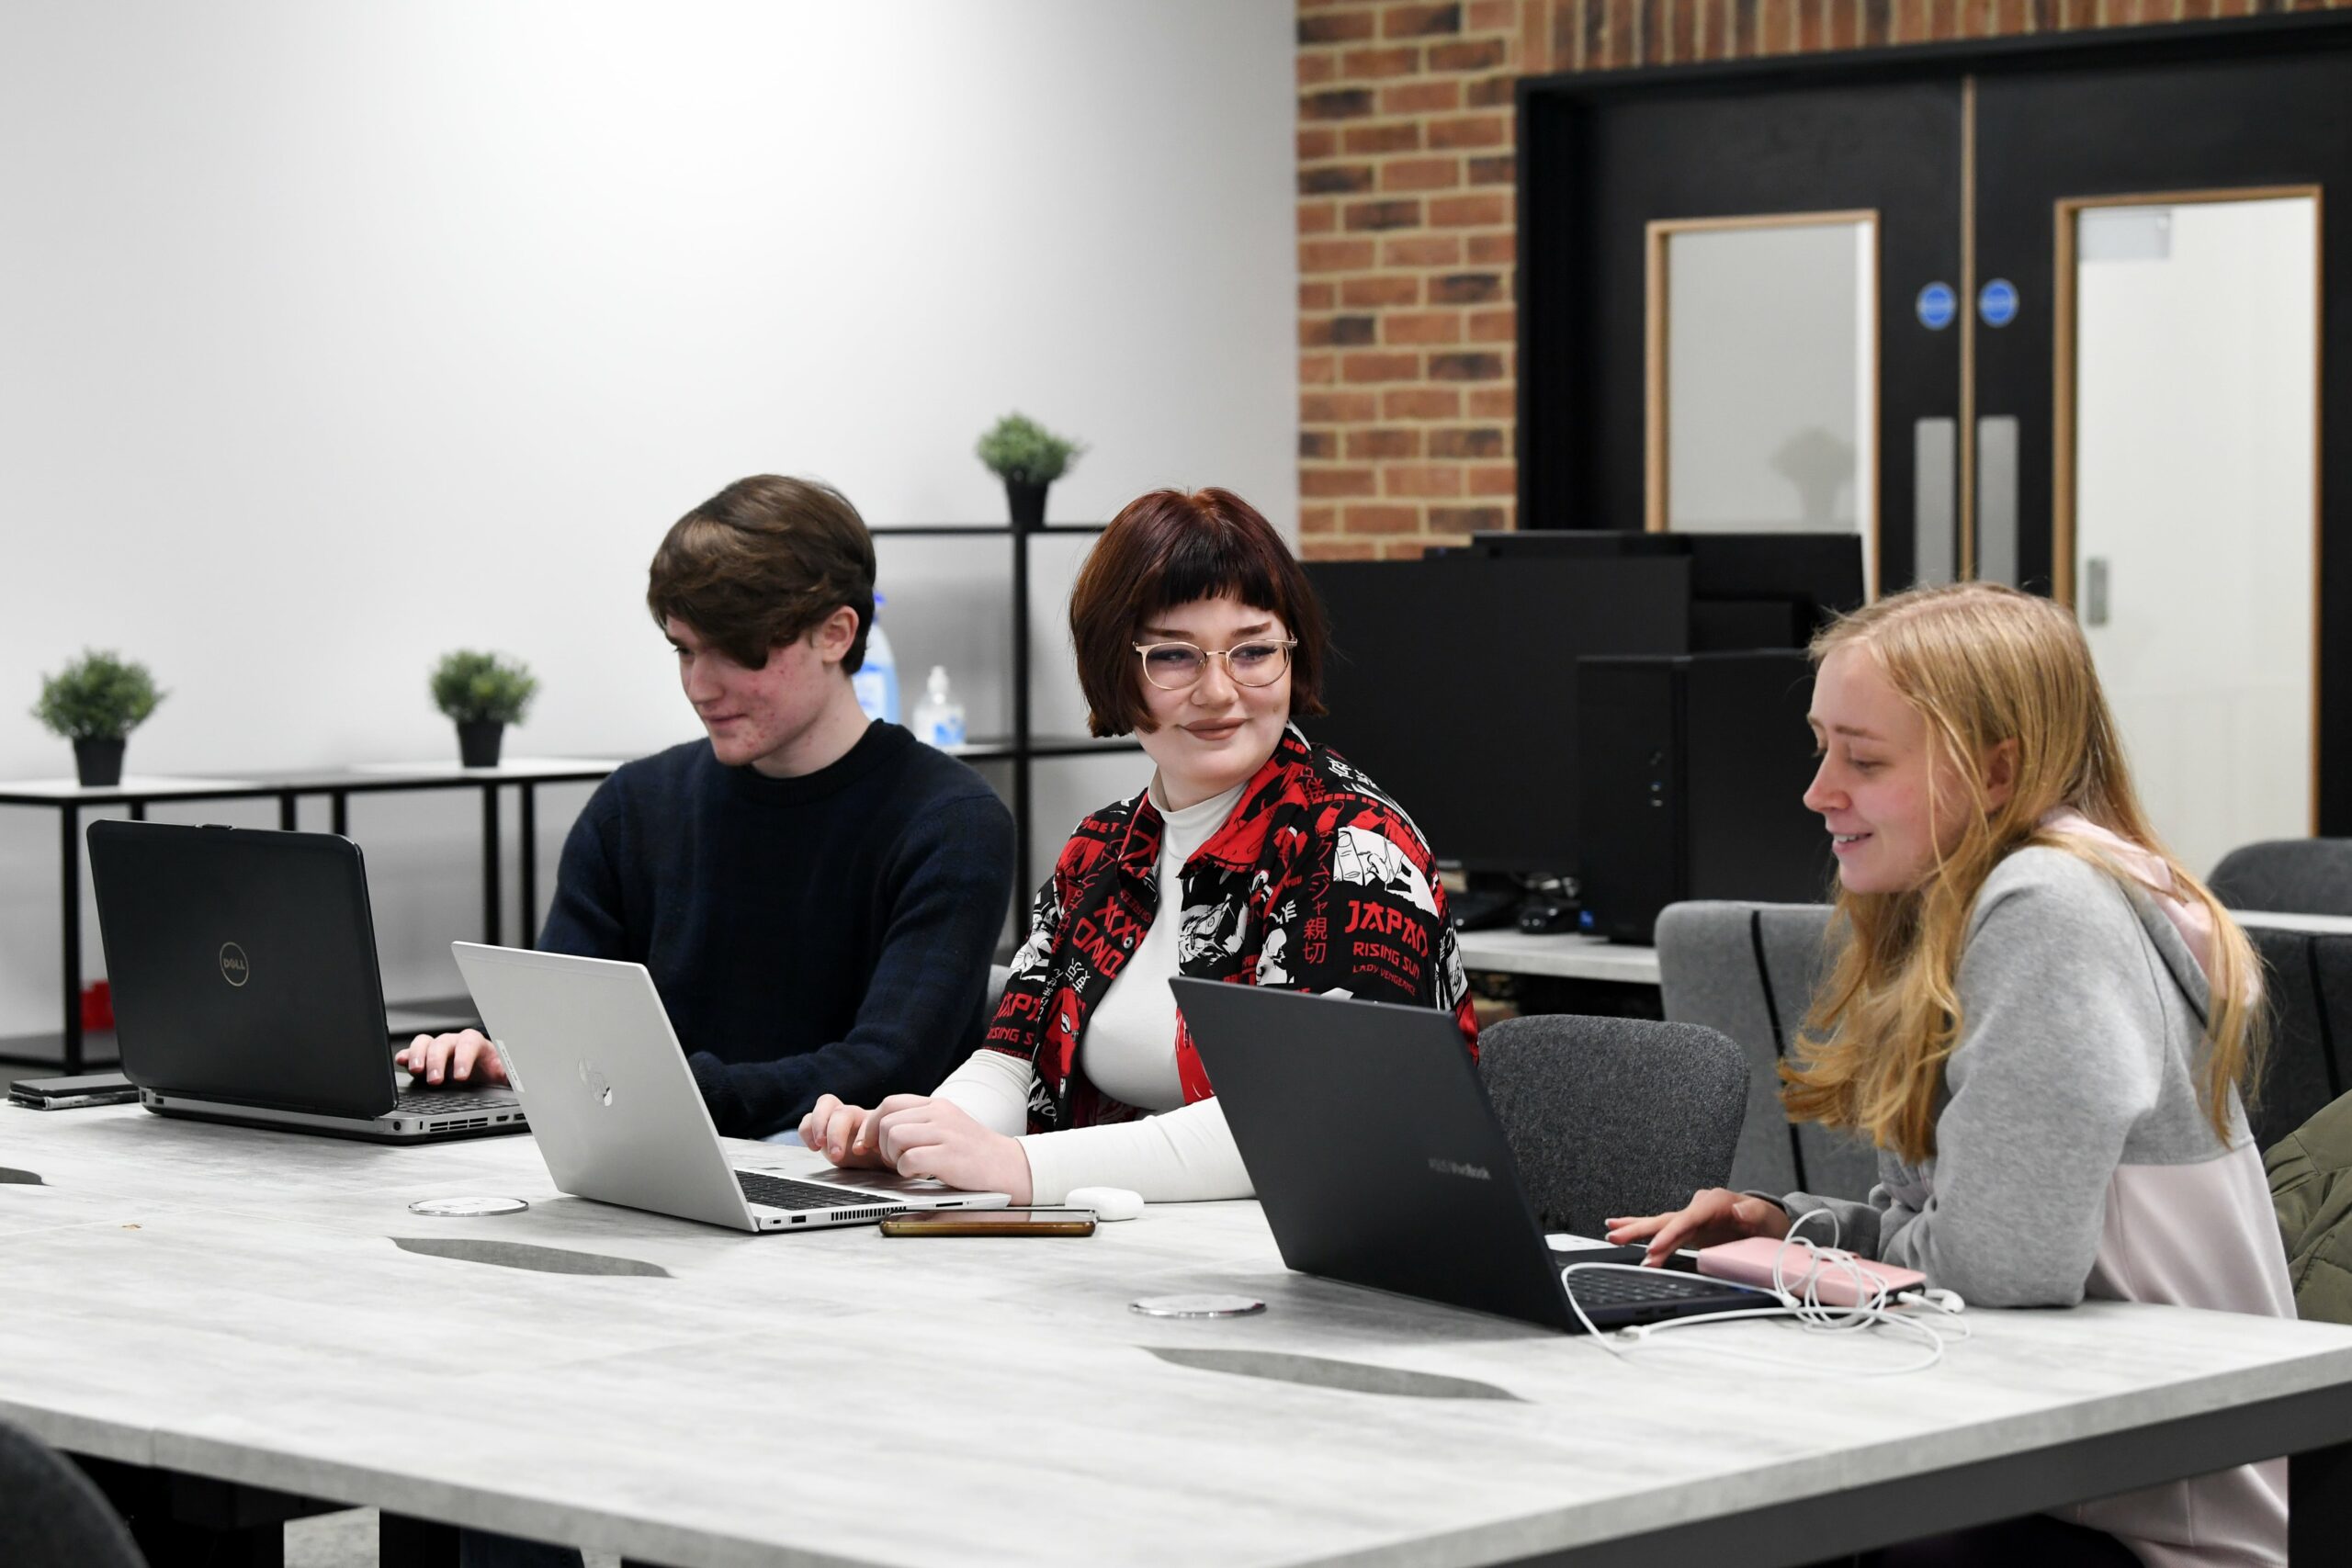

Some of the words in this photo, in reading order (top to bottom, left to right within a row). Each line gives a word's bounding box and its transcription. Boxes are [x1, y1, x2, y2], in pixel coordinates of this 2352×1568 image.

[1344, 899, 1429, 958] JAPAN
[222, 957, 246, 971] DELL
[1352, 941, 1400, 967] RISING
[1402, 955, 1420, 980] SUN
[1352, 964, 1379, 974] LADY
